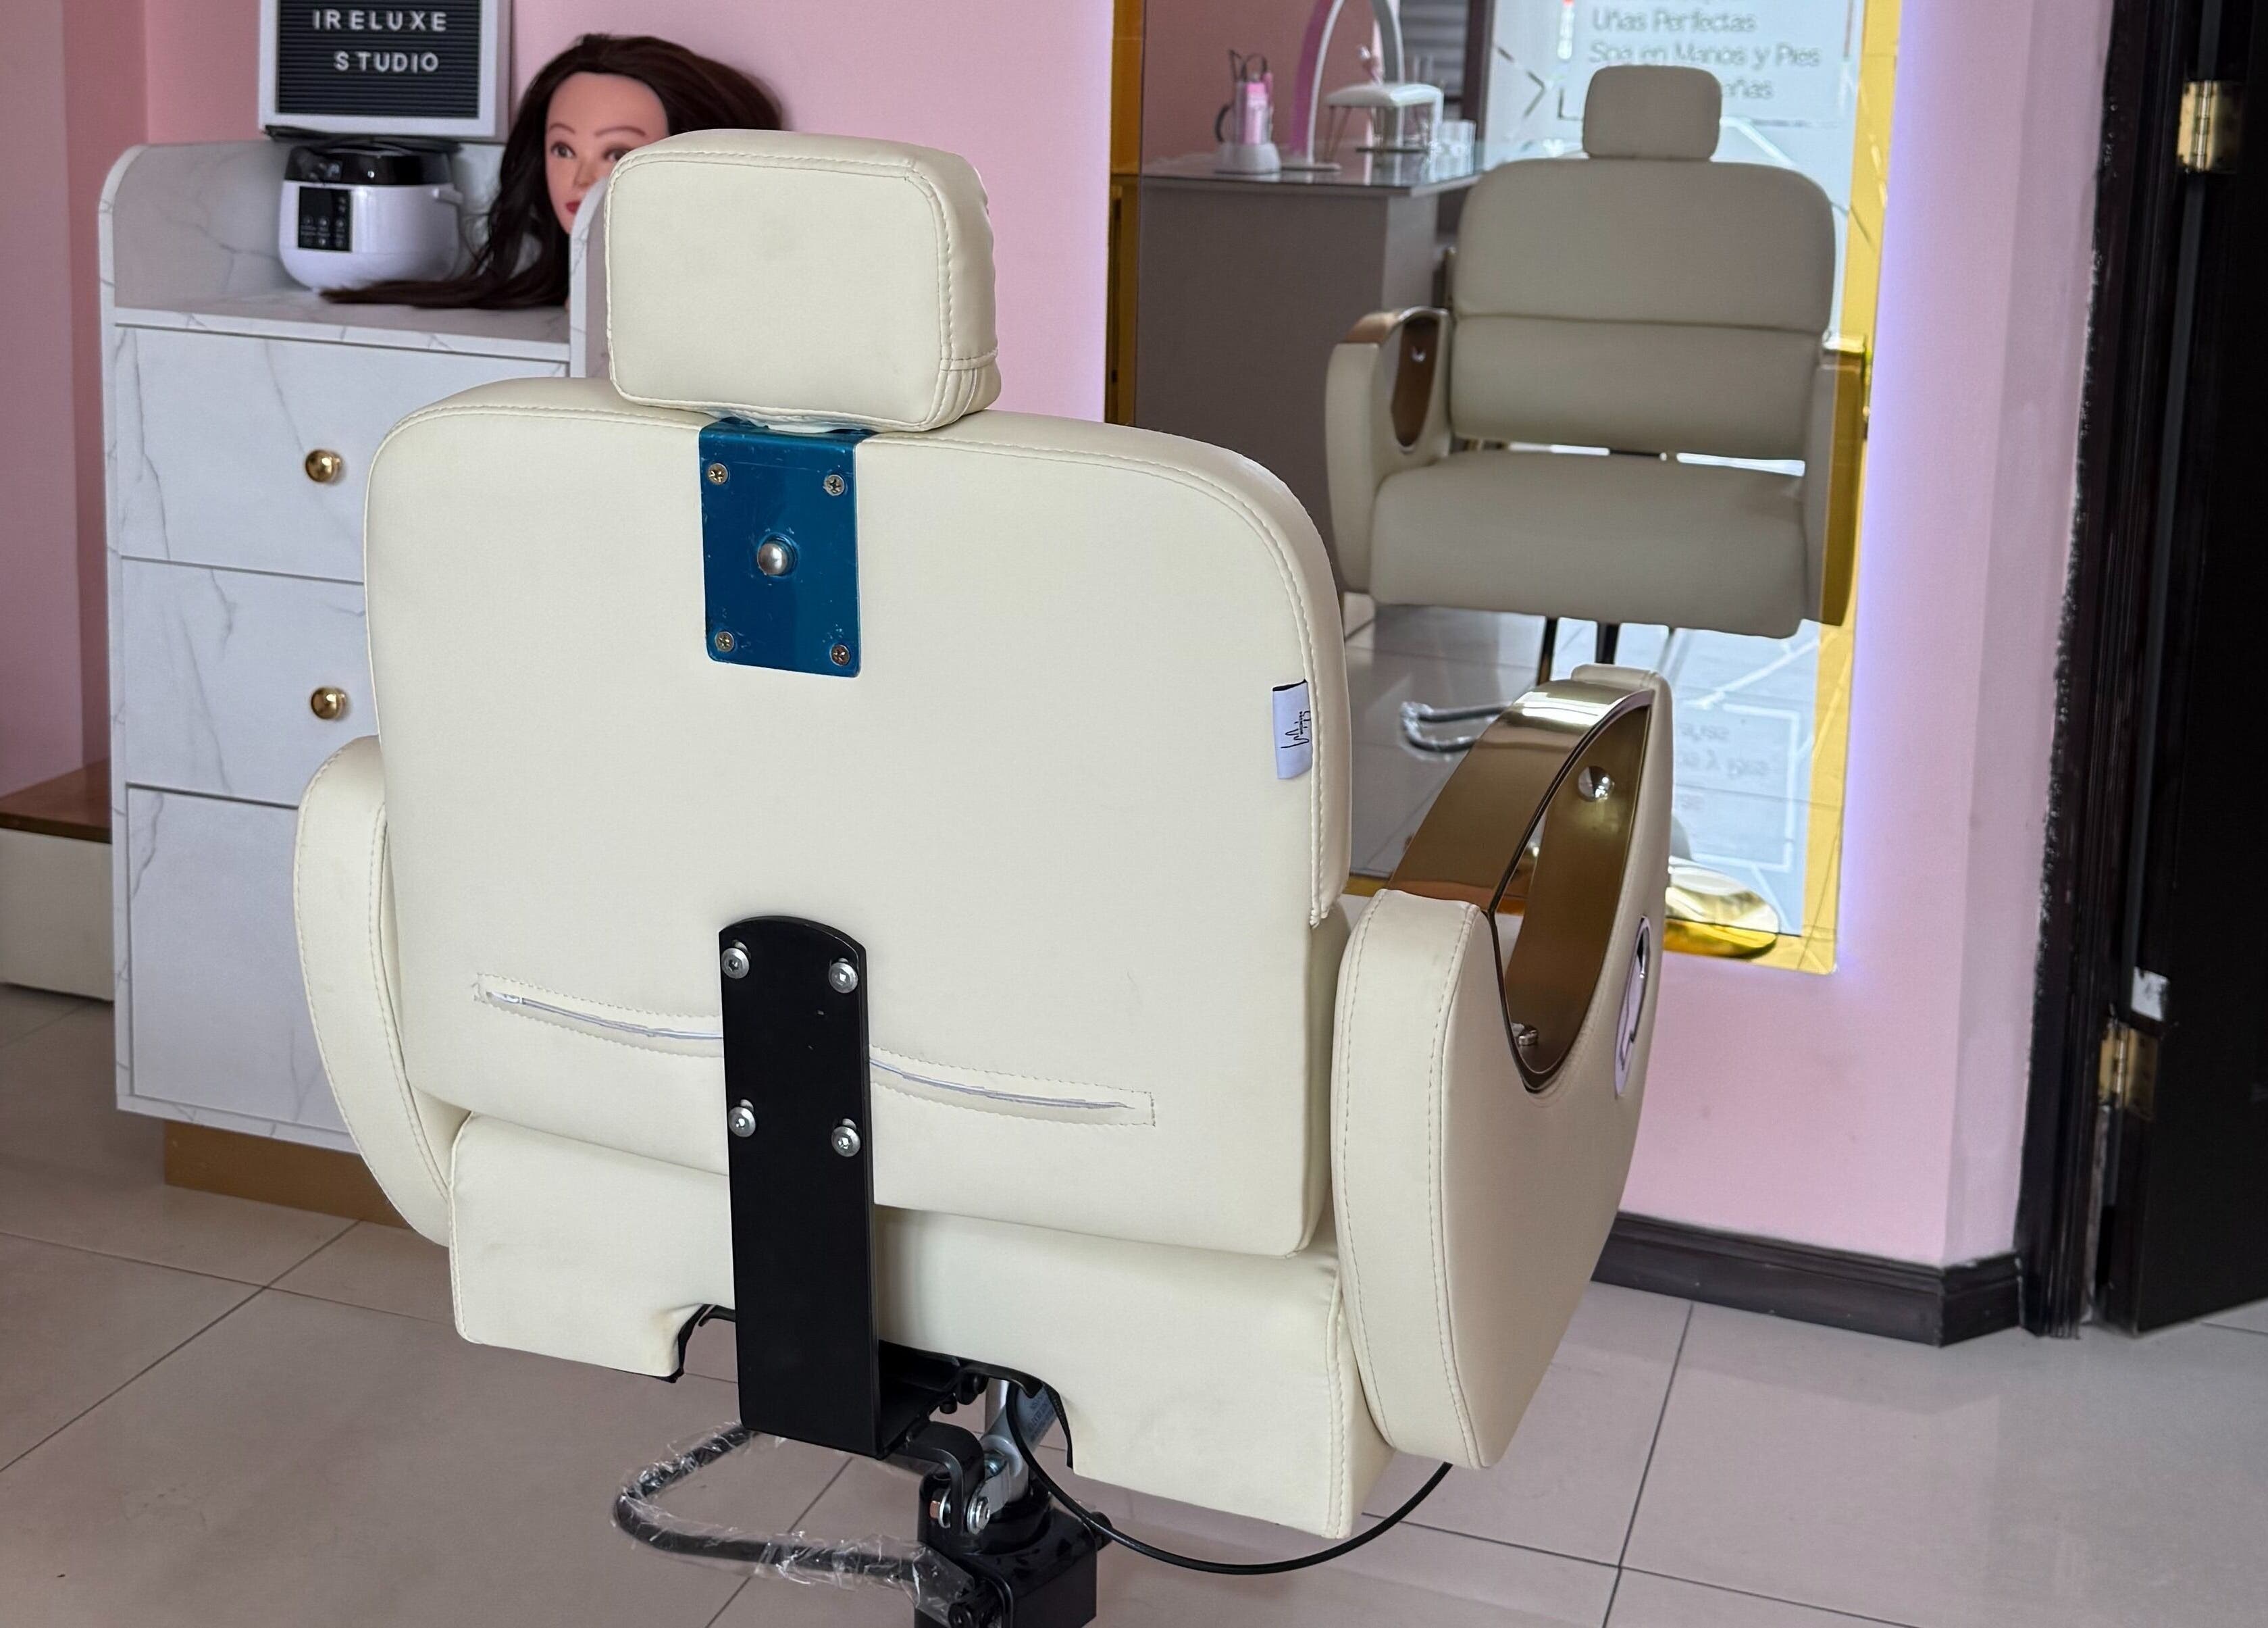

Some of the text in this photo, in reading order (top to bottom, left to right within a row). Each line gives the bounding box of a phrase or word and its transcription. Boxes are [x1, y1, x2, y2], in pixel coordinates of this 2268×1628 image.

[313, 9, 446, 32] IRELUXE
[1592, 7, 1757, 32] Uñas Perfectas
[334, 51, 438, 73] STUDIO
[1588, 40, 1632, 65] Spa
[1674, 41, 1748, 65] Manos
[1754, 46, 1771, 70] y
[1775, 42, 1822, 67] Pies
